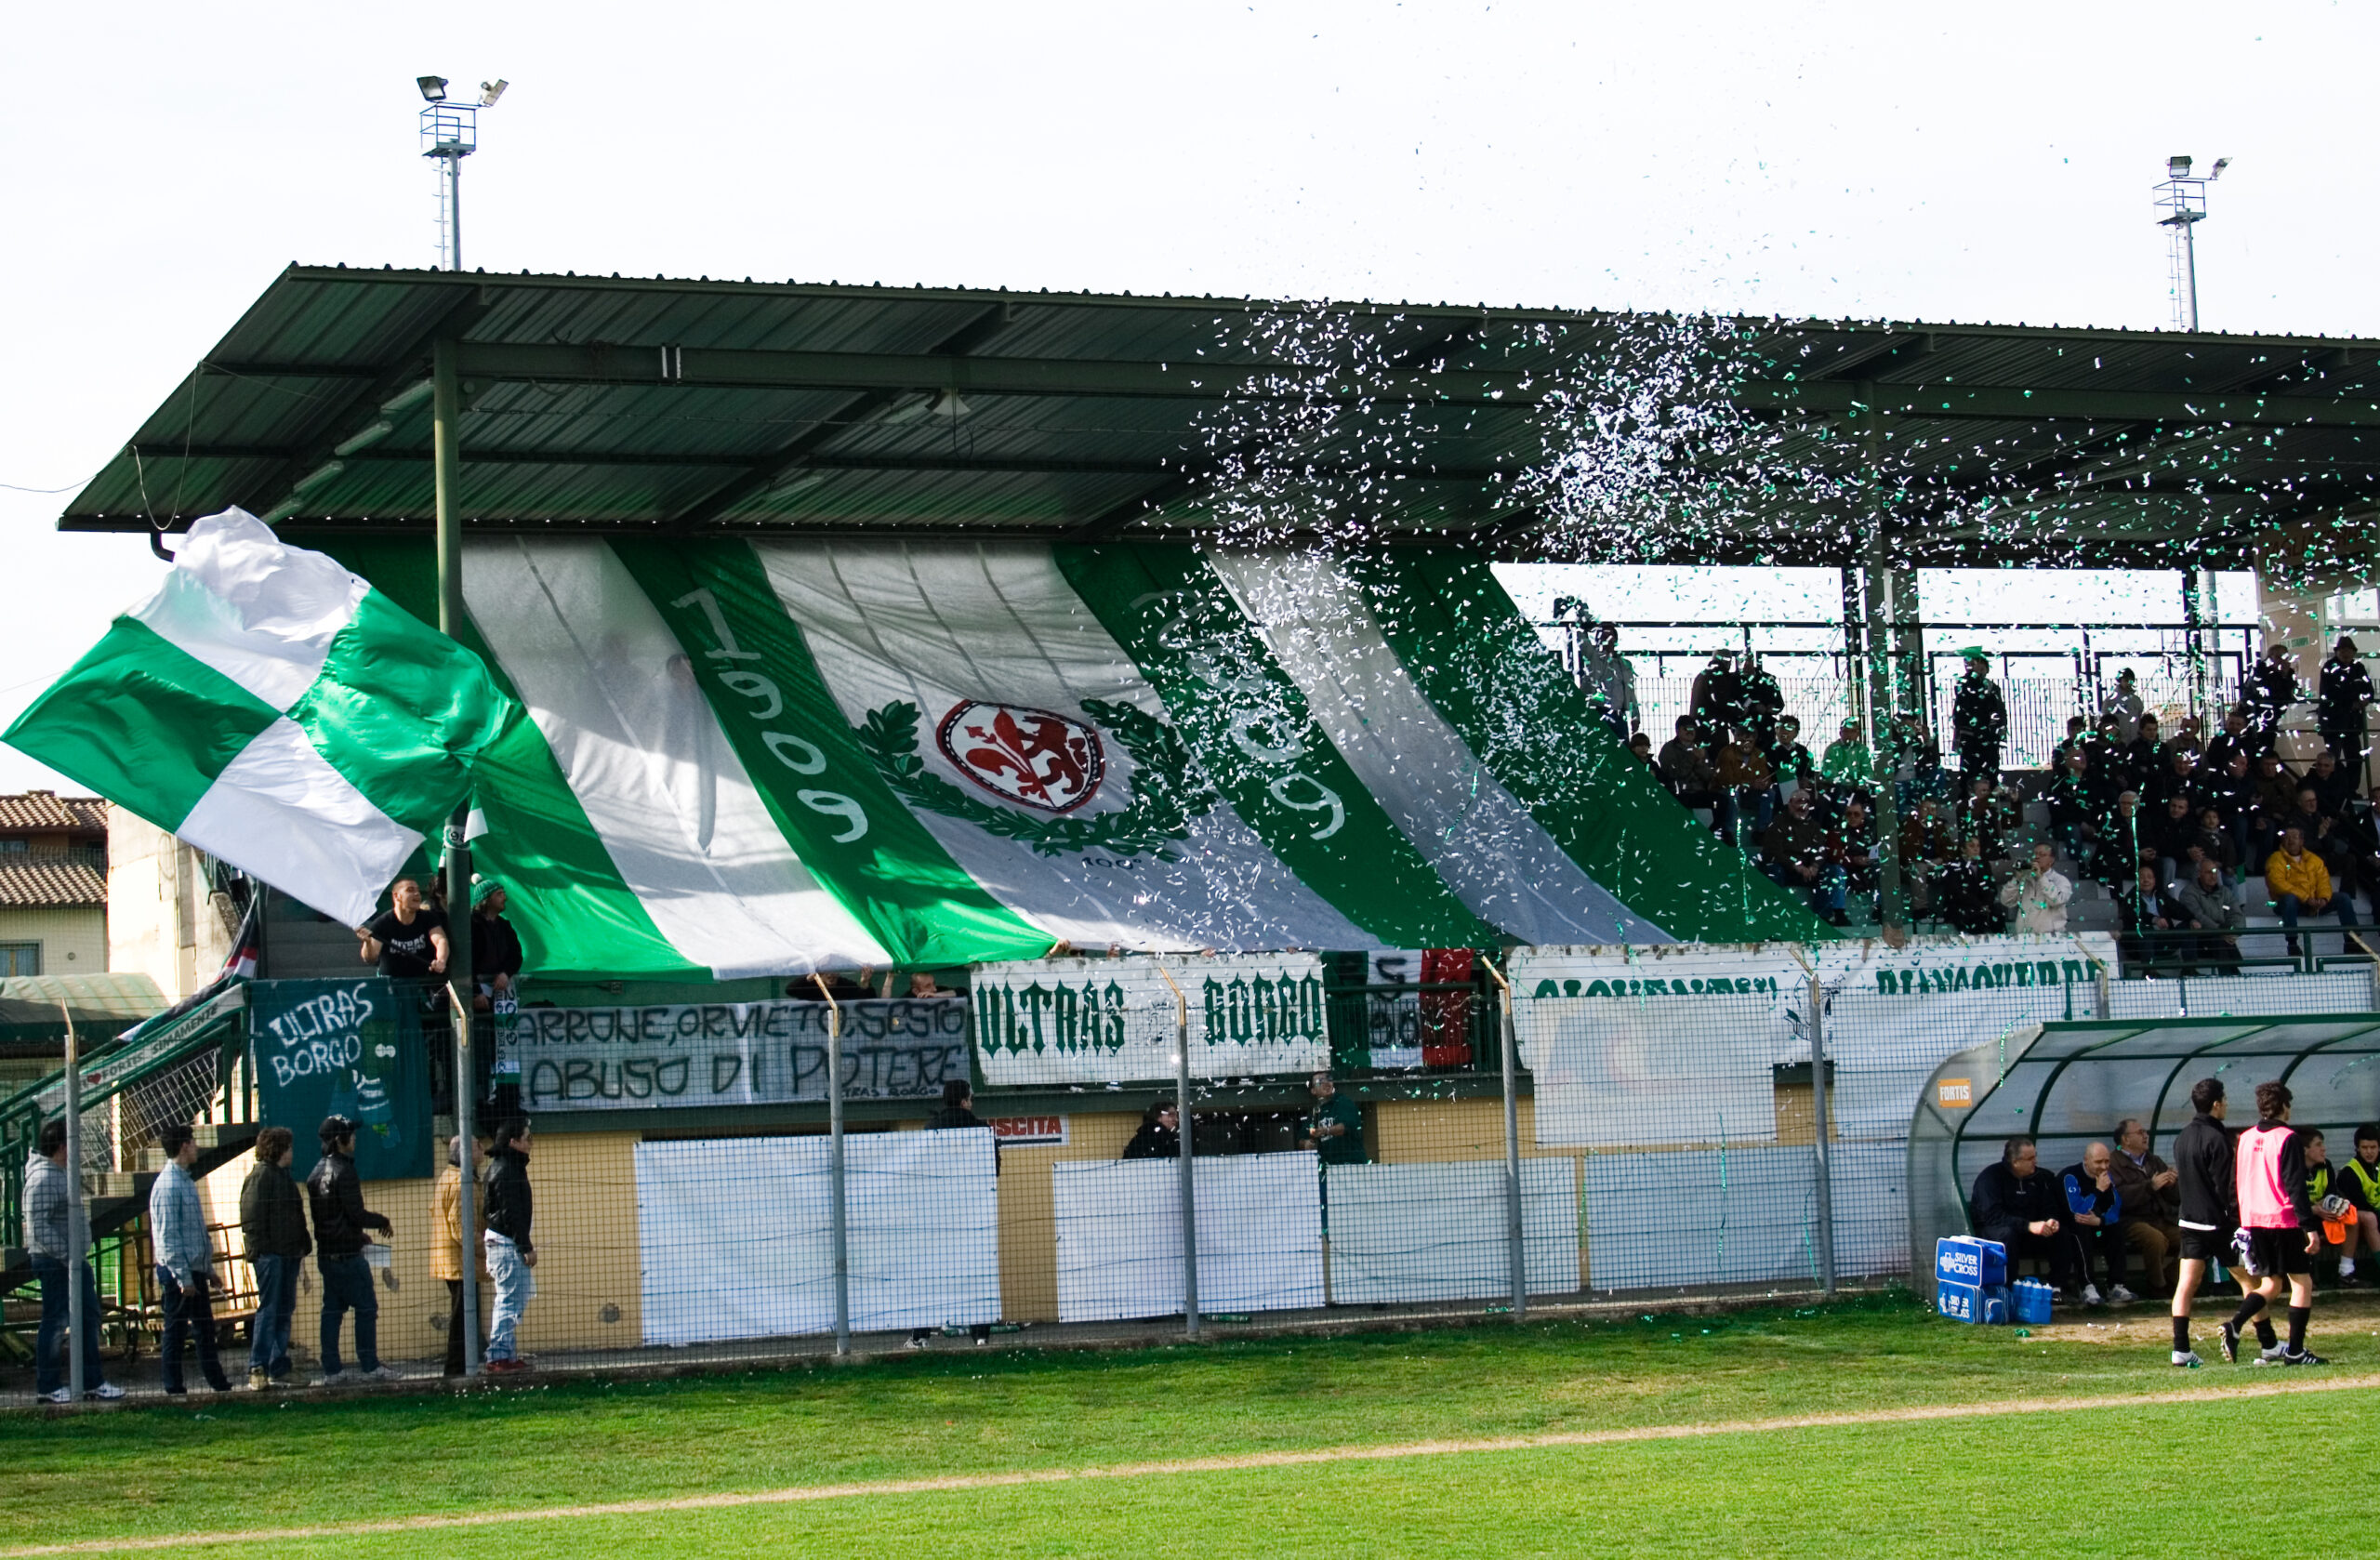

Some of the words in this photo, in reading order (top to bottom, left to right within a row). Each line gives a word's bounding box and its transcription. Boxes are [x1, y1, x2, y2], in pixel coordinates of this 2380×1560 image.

[669, 587, 869, 843] 1909
[269, 982, 374, 1049] ULTRAS
[976, 977, 1125, 1061] ULTRAS
[1203, 969, 1324, 1049] BORGO
[270, 1034, 362, 1088] BORGO
[530, 1054, 690, 1106] ABUSO
[712, 1053, 761, 1095] DI
[790, 1044, 963, 1093] POTERE
[1939, 1085, 1970, 1101] FORTIS
[1953, 1251, 1978, 1265] SILVER
[1953, 1263, 1978, 1277] CROSS
